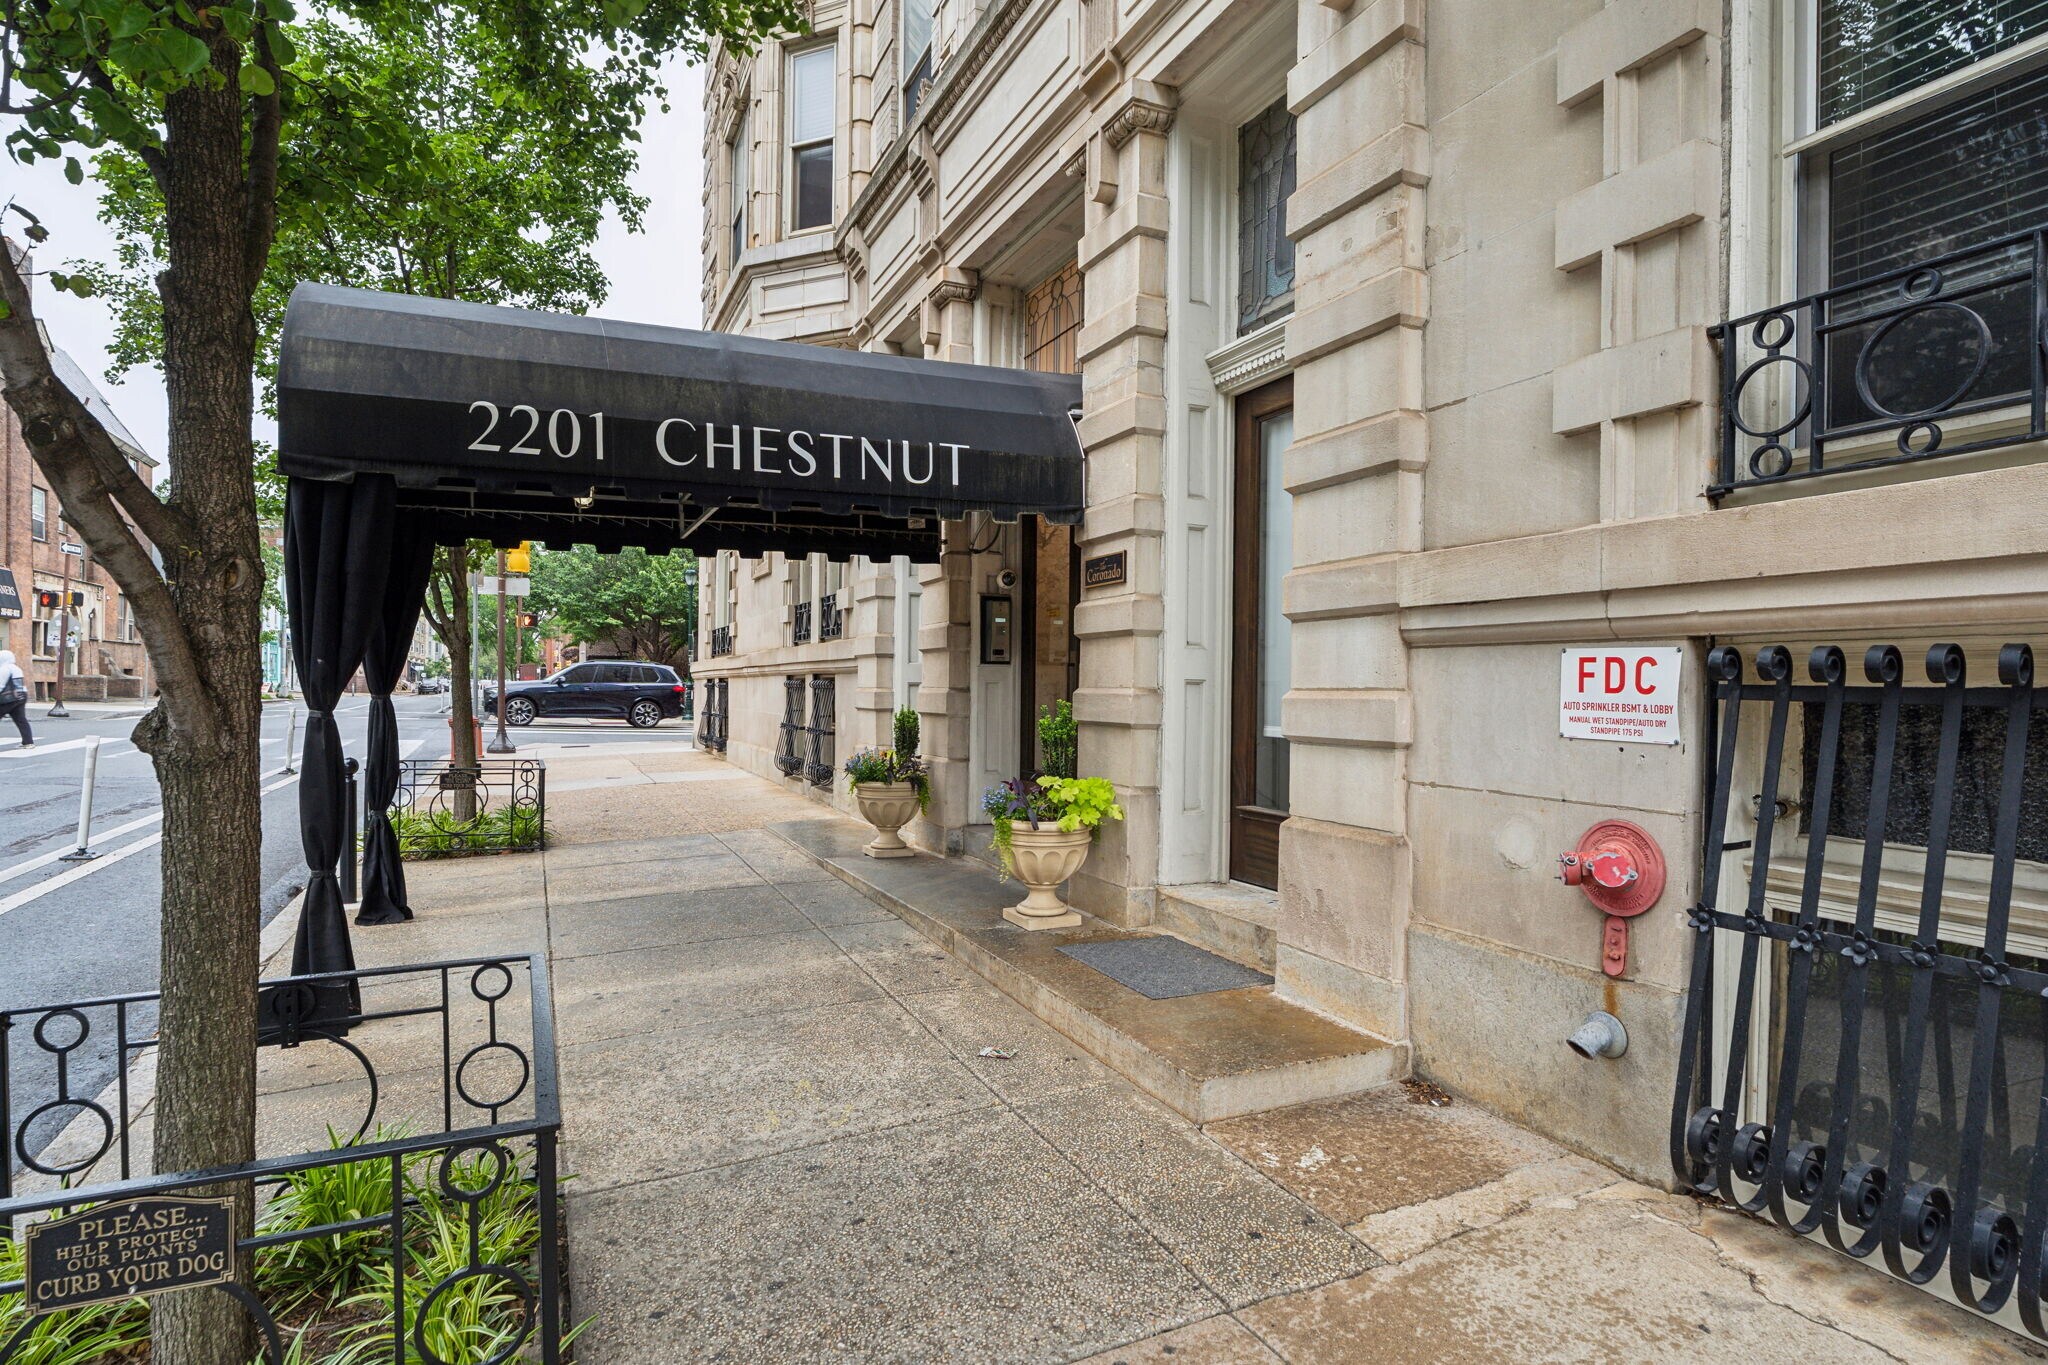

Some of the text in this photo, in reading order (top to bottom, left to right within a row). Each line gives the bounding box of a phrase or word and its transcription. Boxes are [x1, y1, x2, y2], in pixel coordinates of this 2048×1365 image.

[466, 400, 971, 487] 2201 CHESTNUT
[1087, 563, 1121, 583] Coronado
[1578, 656, 1658, 695] FDC
[1563, 701, 1674, 715] AUTO SPRINKLER BSMT & LOBBY
[1568, 716, 1667, 728] MANUAL WET STANDPIPE/AUTO DRY
[1590, 727, 1621, 736] STANDPIPE
[1622, 728, 1633, 736] 175
[78, 1207, 209, 1241] PLEASE...
[56, 1225, 208, 1262] HELP PROTECT
[67, 1239, 198, 1272] OUR PLANTS
[36, 1250, 225, 1301] CURB YOUR DOG
